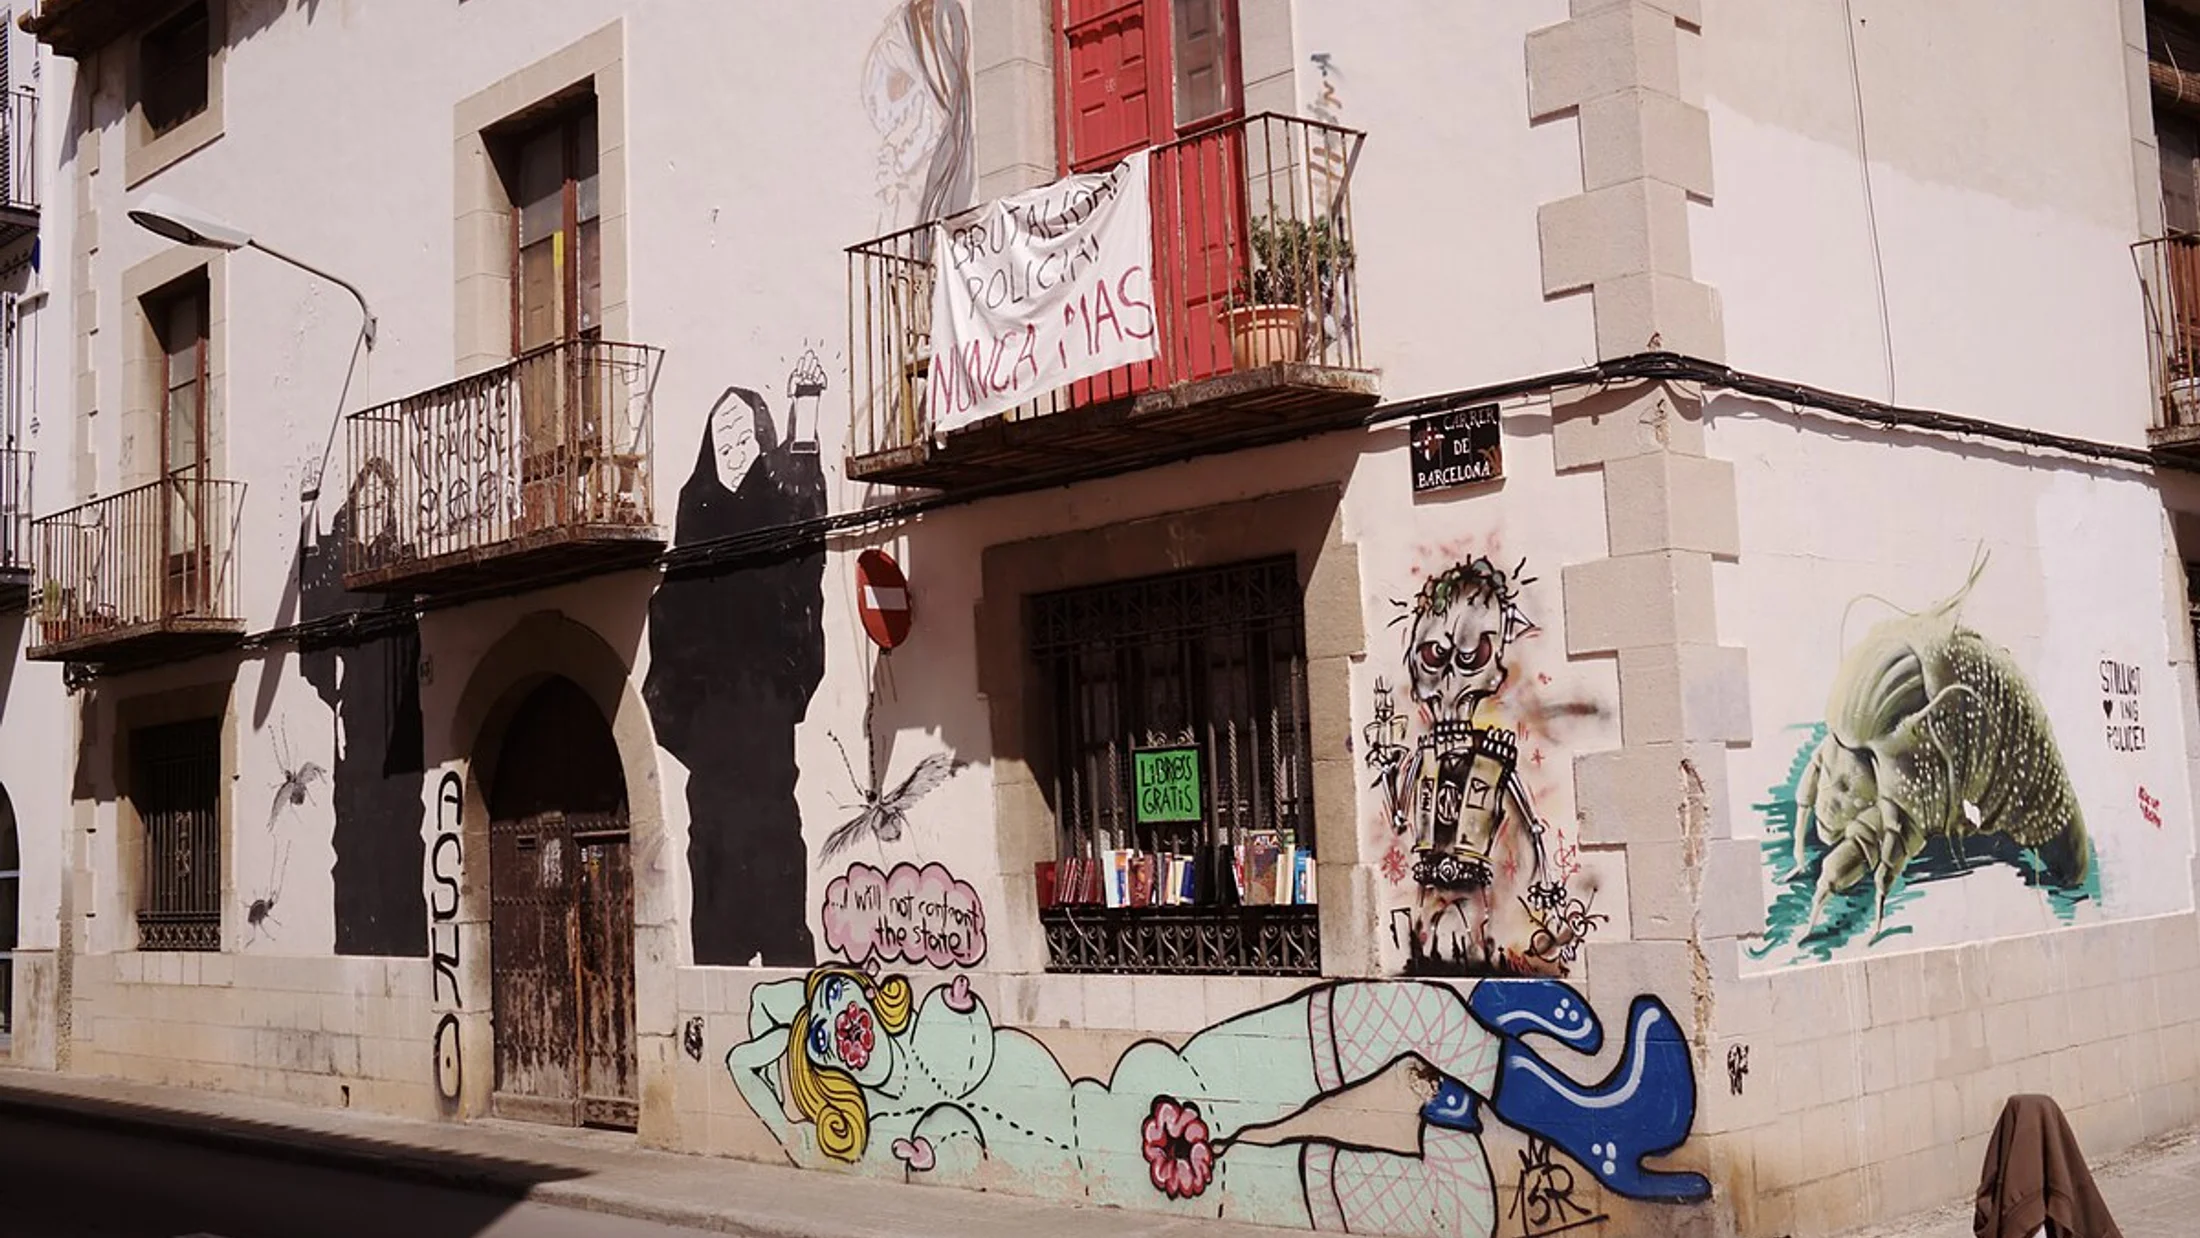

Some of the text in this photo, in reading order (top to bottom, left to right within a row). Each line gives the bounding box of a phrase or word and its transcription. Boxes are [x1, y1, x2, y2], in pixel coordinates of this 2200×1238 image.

[931, 323, 1038, 421] NUNCA
[1443, 408, 1498, 431] CARRER
[1453, 438, 1470, 456] DE
[1417, 461, 1490, 489] BARCELONA
[890, 890, 914, 921] not
[874, 914, 907, 947] the
